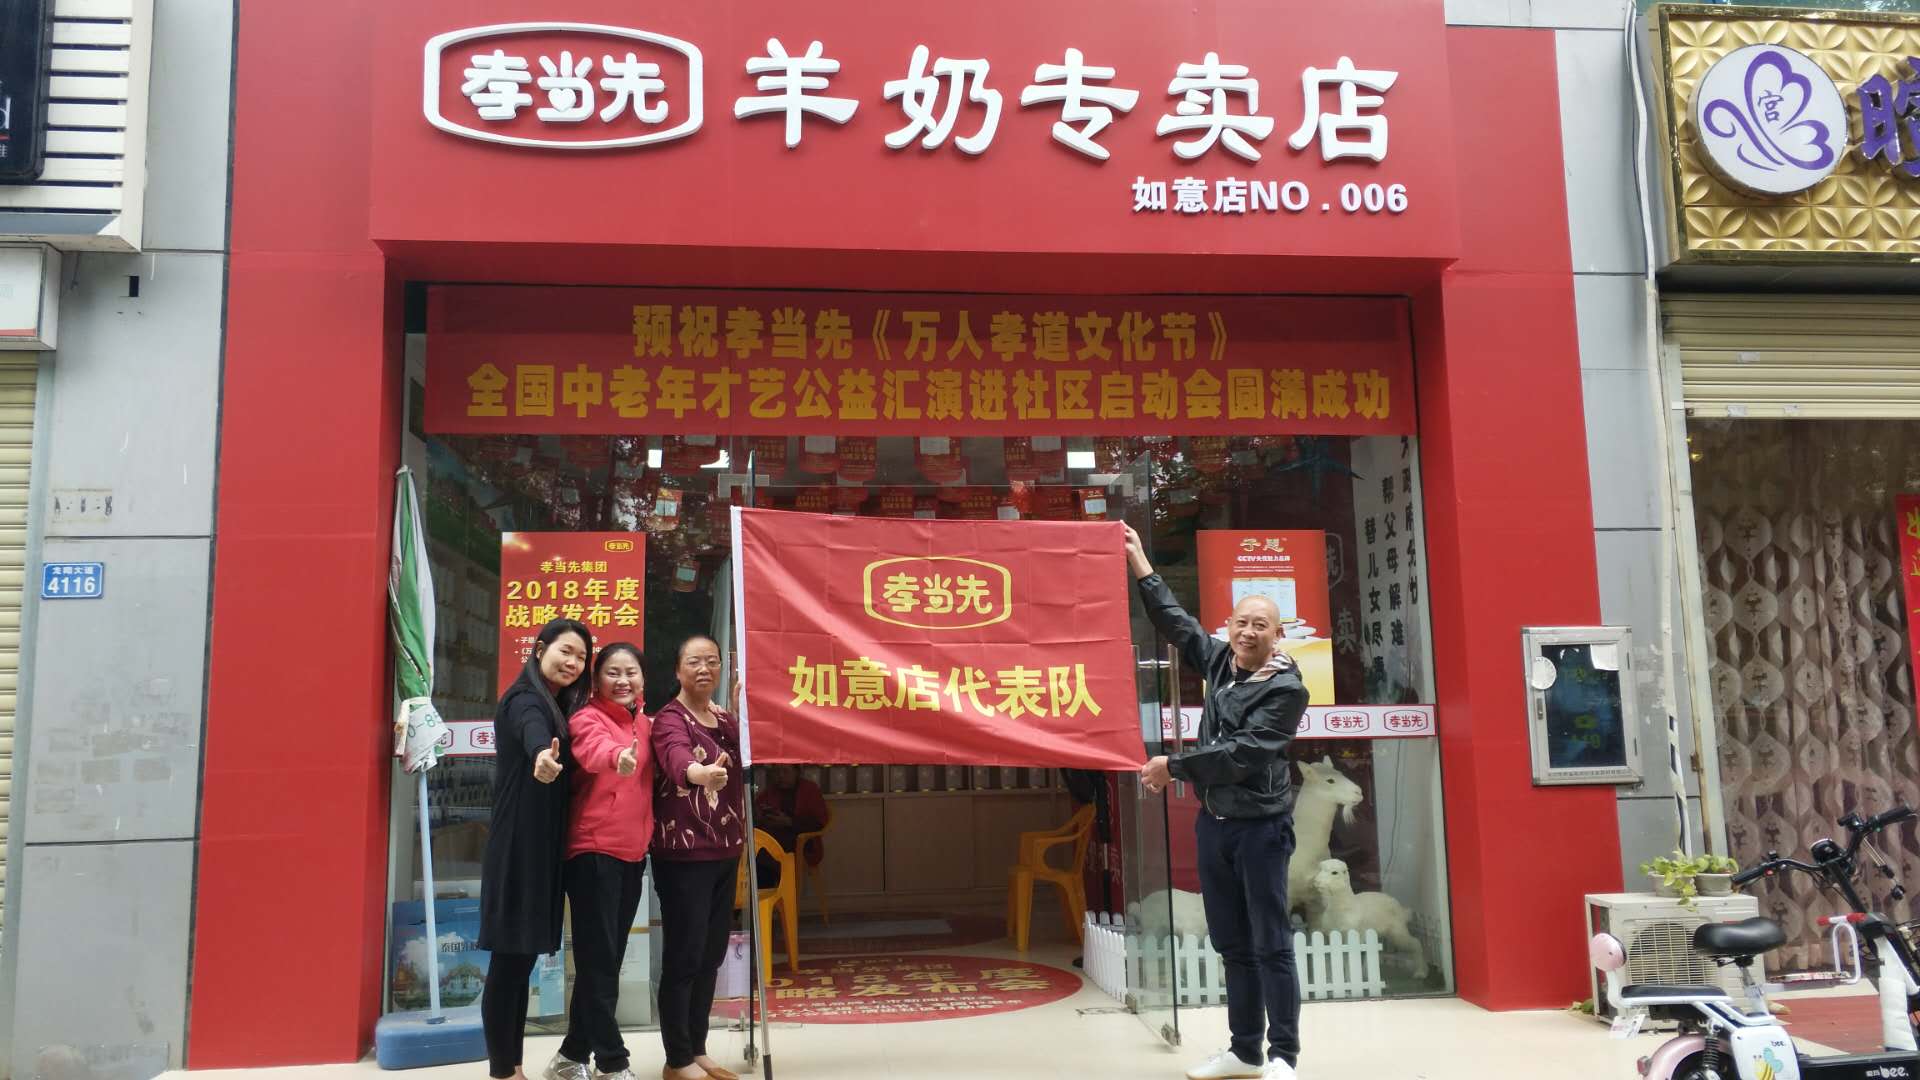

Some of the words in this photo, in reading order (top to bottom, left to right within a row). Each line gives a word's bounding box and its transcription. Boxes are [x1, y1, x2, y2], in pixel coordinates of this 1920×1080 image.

[461, 49, 669, 124] 孝当先
[734, 38, 1398, 163] 羊奶专卖店
[1757, 89, 1784, 123] 宫
[632, 305, 1228, 362] 预祝孝当先《万人孝道文化节》
[466, 363, 1391, 421] 全国中老年才艺公益汇演进社区启动会圆满成功
[540, 560, 608, 573] 孝当先集团
[48, 576, 96, 594] 4116
[506, 577, 640, 602] 2018年度
[882, 572, 994, 615] 孝当先
[505, 602, 640, 628] 战略发布会
[788, 655, 1103, 720] 如意店代表队
[1330, 715, 1365, 729] 孝当先
[1389, 715, 1425, 728] 孝当先
